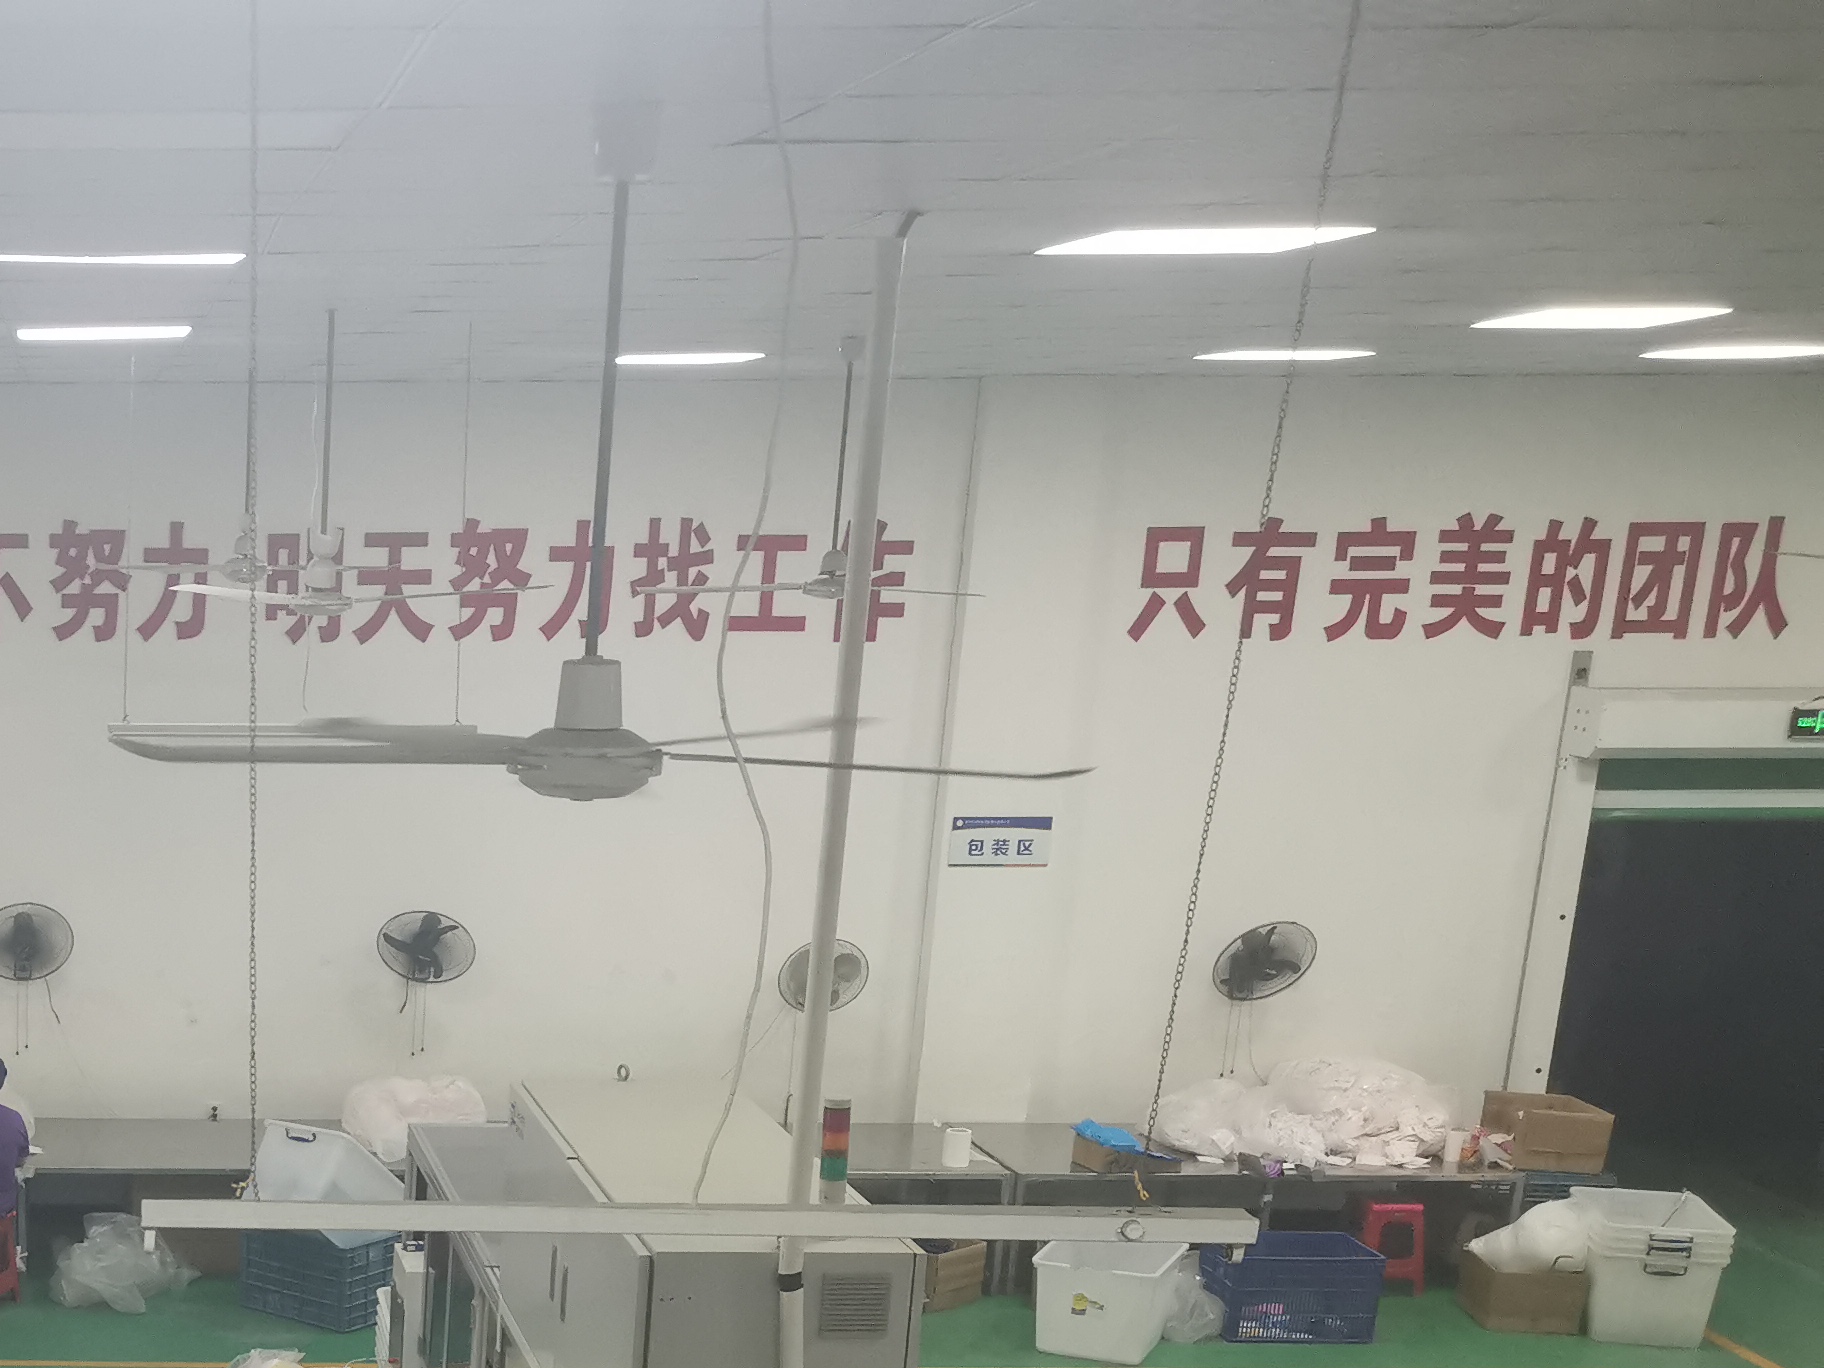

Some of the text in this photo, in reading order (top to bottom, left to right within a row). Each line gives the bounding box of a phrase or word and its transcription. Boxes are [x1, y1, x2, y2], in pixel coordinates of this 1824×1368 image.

[265, 517, 915, 644] 明天努力找工作
[1126, 512, 1788, 642] 只有完美的团队
[967, 838, 1034, 857] 包装区
